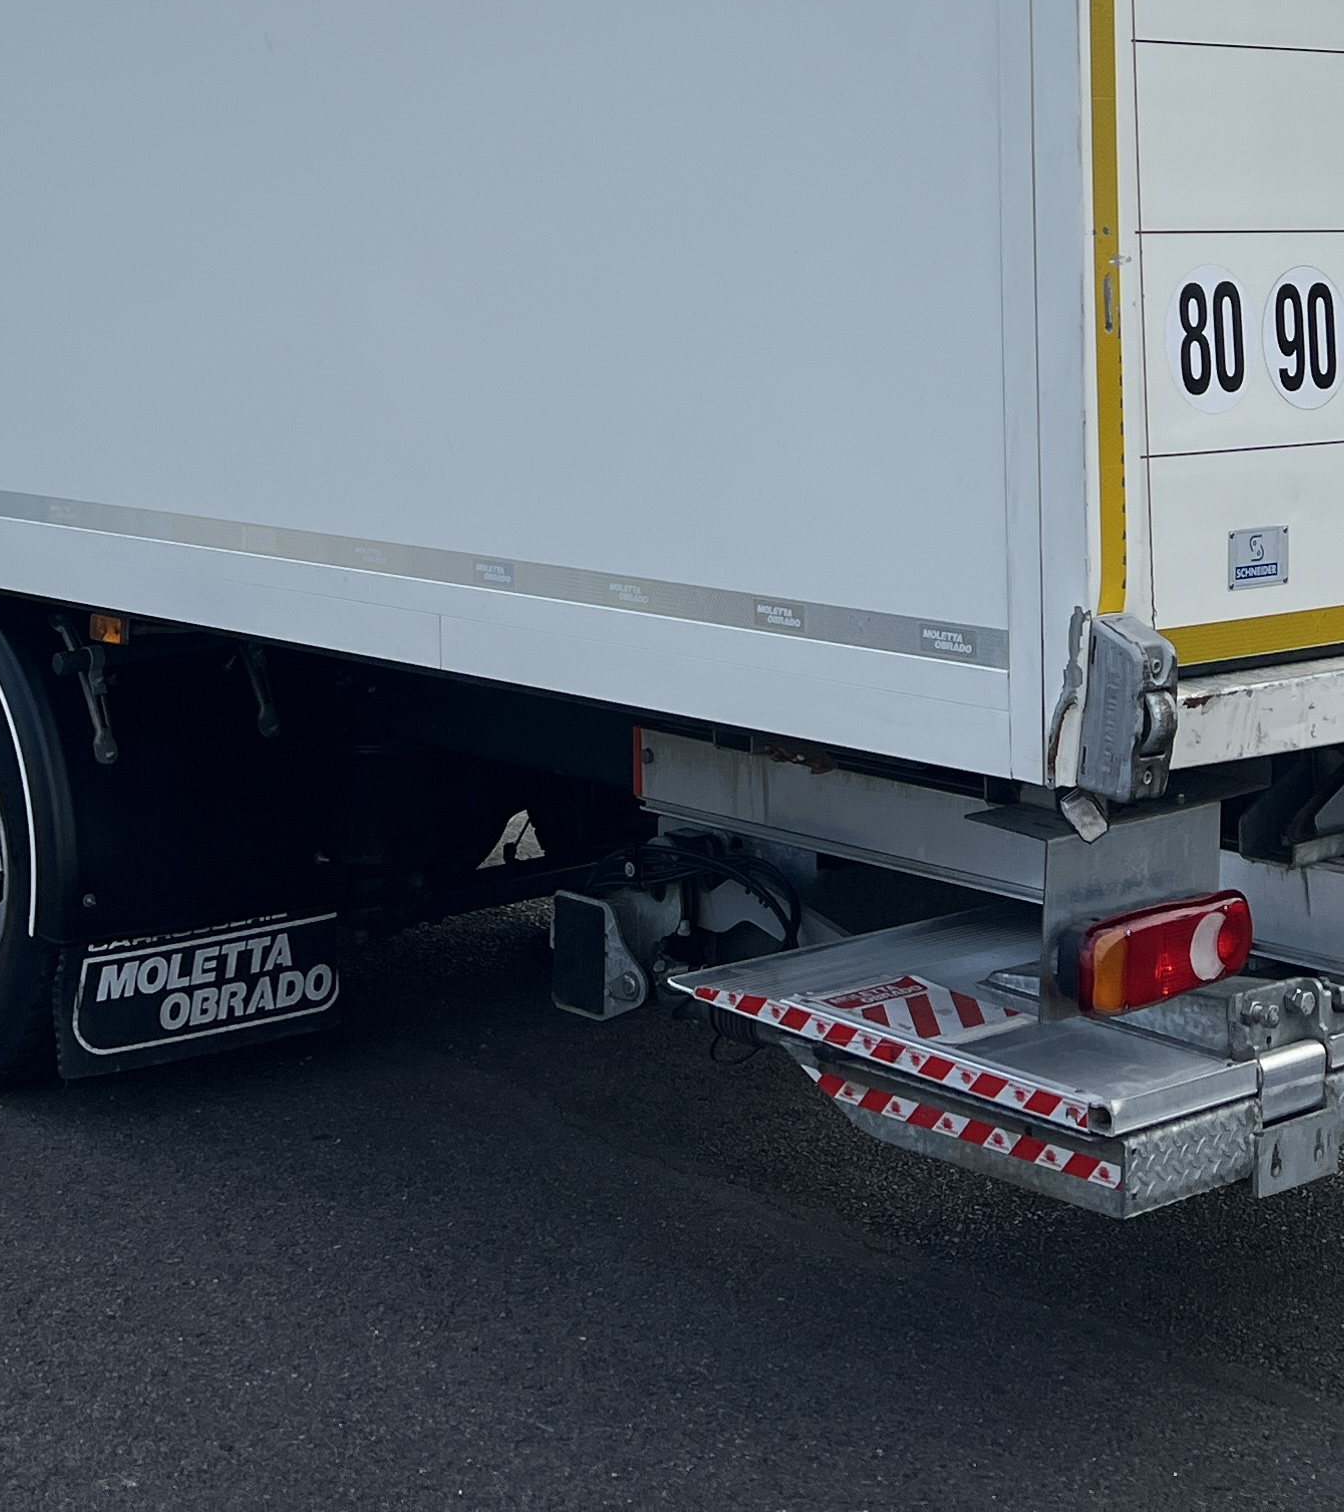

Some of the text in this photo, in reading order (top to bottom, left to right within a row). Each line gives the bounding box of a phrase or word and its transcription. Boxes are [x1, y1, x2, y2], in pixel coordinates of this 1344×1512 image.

[1179, 280, 1244, 396] 80
[1275, 281, 1337, 392] 90
[1236, 563, 1278, 579] SCHNEIDER
[757, 604, 793, 617] MOLETTA
[922, 628, 963, 643] MOLETTA
[934, 641, 973, 654] OBRADO
[96, 933, 293, 1003] MOLETTA
[159, 963, 333, 1031] OBRADO
